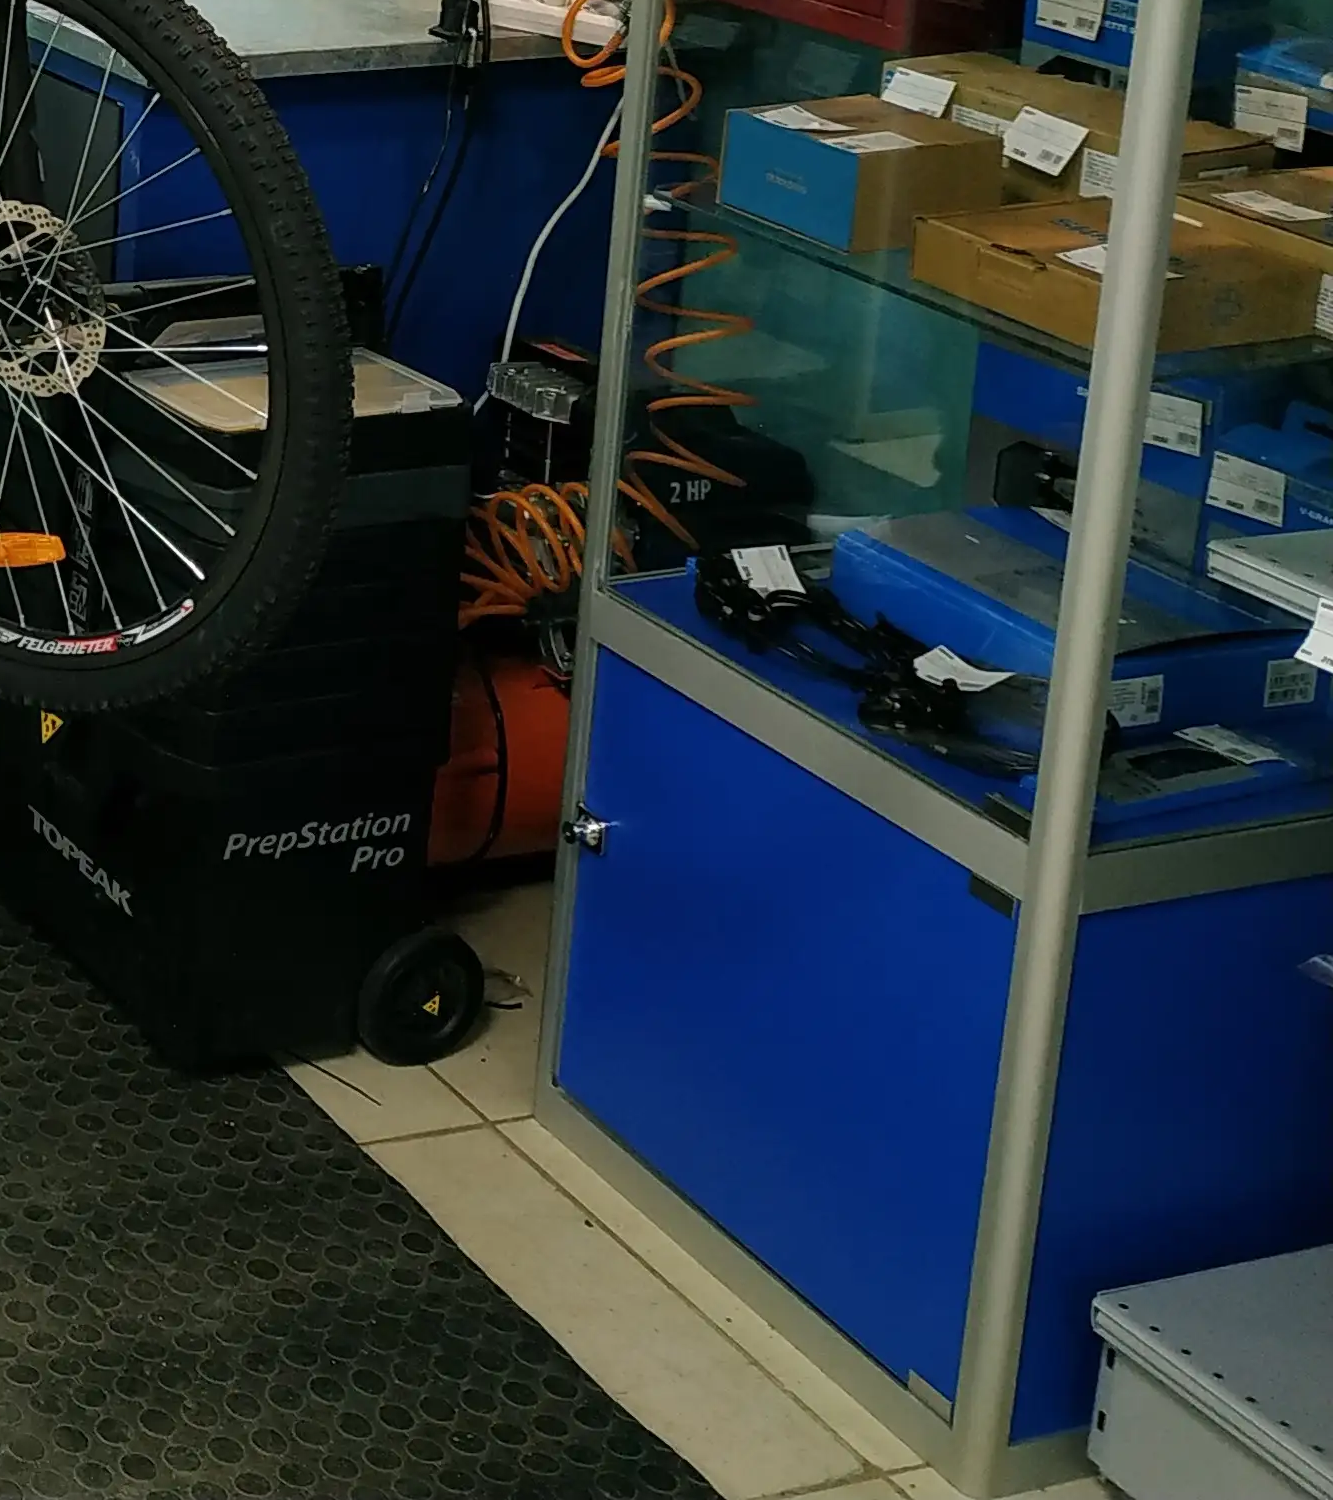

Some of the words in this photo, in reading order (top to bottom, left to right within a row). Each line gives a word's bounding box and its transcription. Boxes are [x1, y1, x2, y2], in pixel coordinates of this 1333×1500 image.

[669, 481, 681, 504] 2
[686, 479, 713, 502] HP
[17, 636, 115, 656] FELGEBIETER
[223, 812, 411, 861] PrepStation
[28, 805, 135, 917] TOPEAK
[350, 843, 405, 873] Pro
